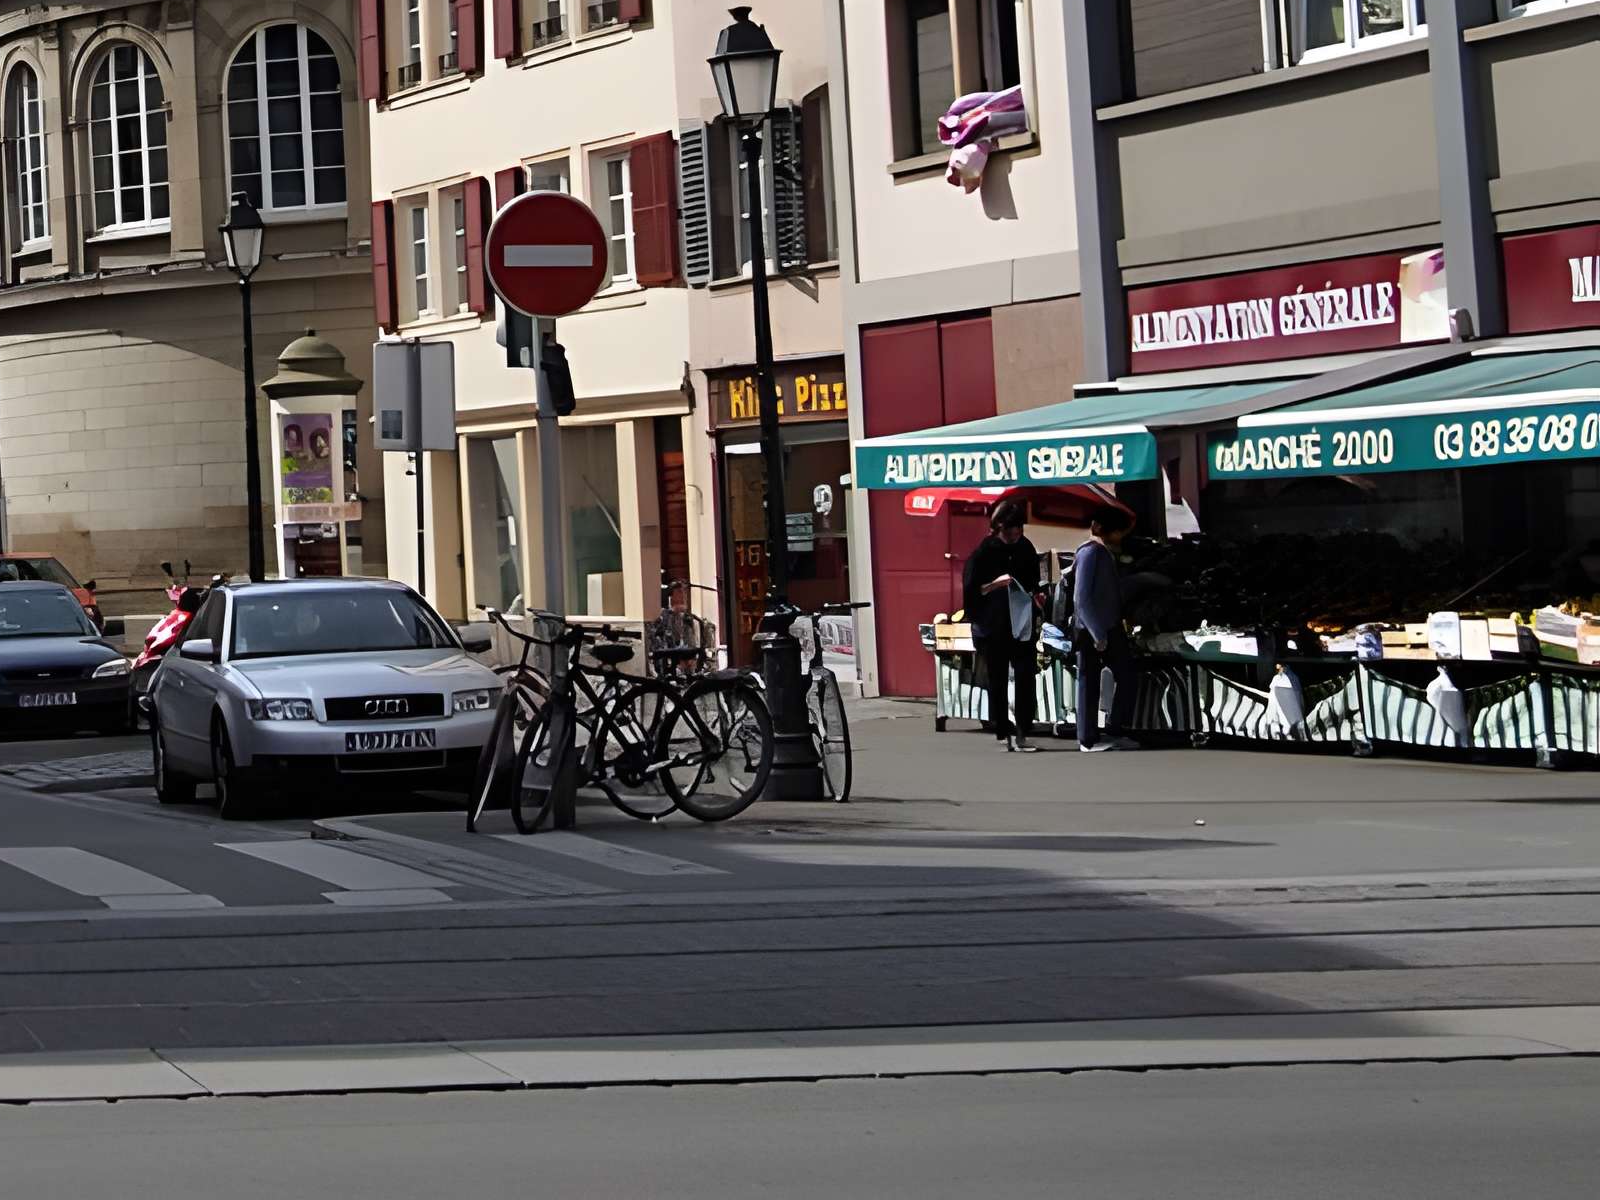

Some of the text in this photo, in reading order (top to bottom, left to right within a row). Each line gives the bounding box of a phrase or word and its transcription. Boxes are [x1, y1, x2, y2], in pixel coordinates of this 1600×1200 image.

[1214, 426, 1322, 472] MARCHÉ
[1332, 428, 1394, 467] 2000
[1433, 423, 1464, 460] 03
[1469, 419, 1501, 457] 88
[1538, 413, 1577, 451] 08
[1580, 412, 1600, 450] 0
[884, 451, 1018, 484] ALIMENTATION
